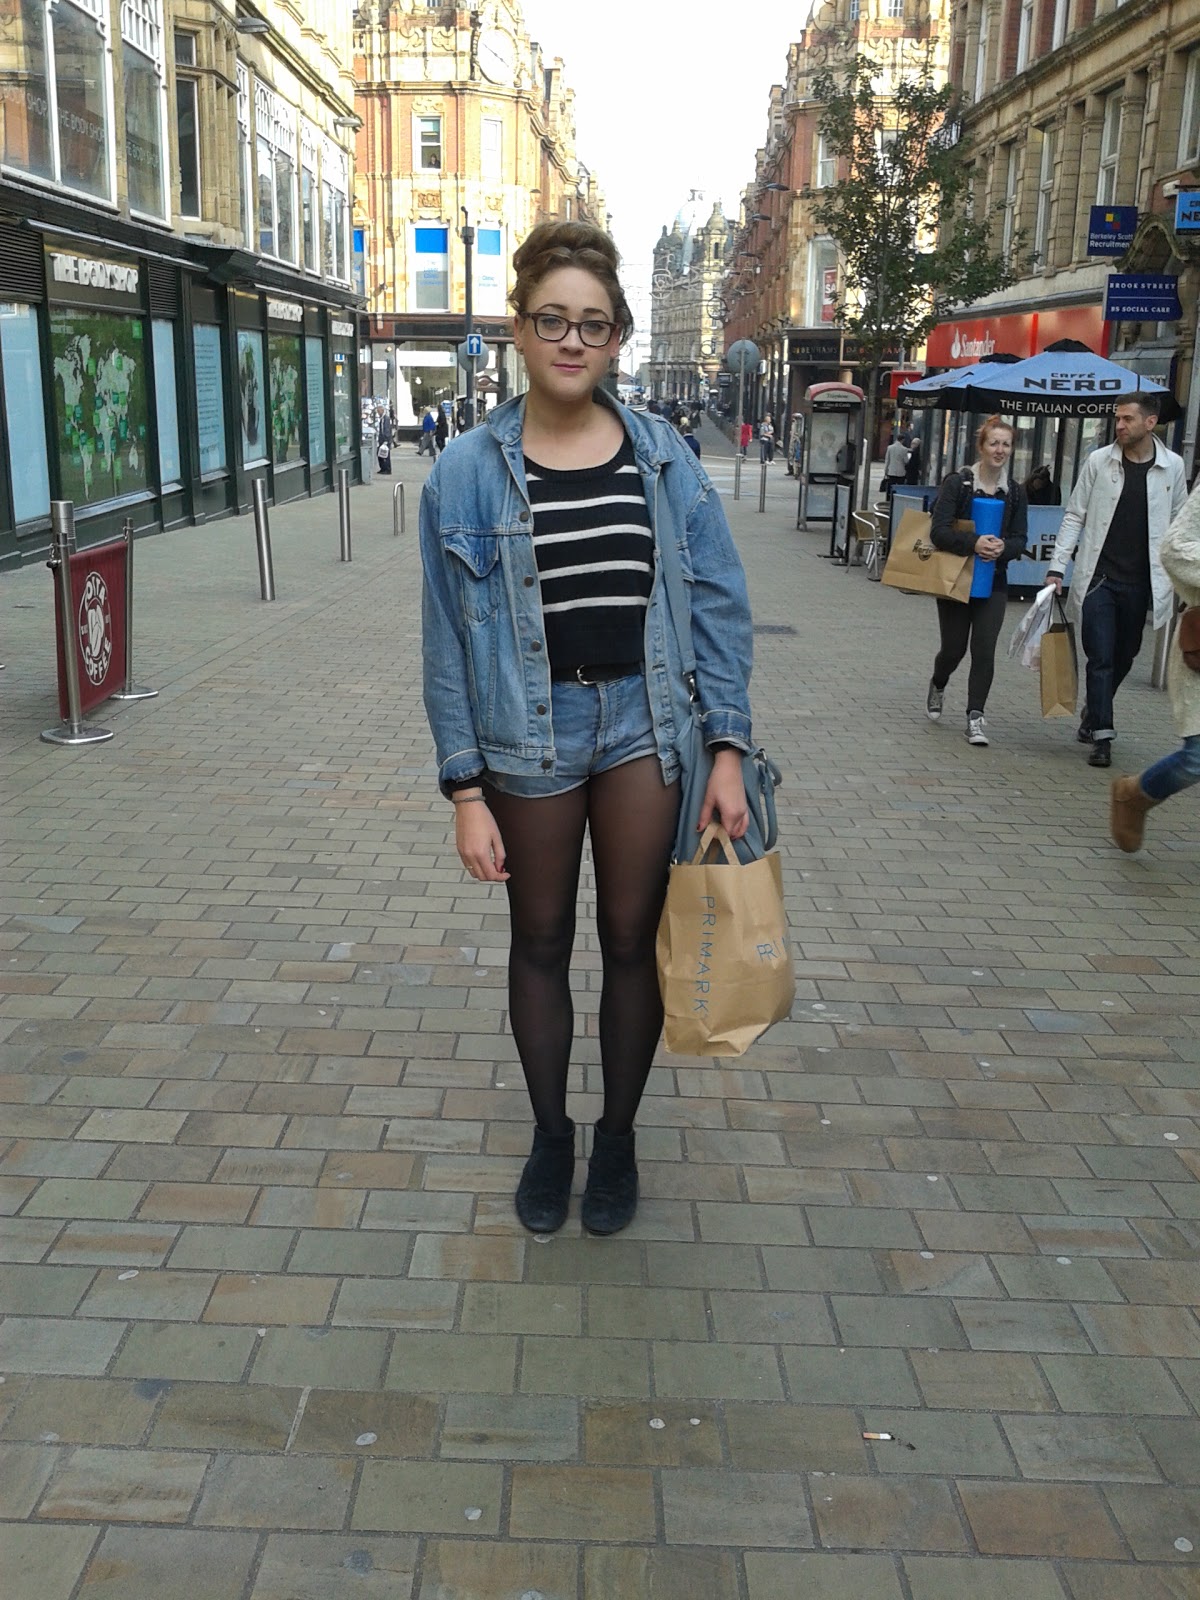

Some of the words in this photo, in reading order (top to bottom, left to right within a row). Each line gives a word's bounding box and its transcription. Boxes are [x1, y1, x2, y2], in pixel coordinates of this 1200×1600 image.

[1089, 240, 1131, 249] Recruitmen
[1090, 233, 1117, 241] Berkeley
[49, 252, 80, 284] THE
[960, 330, 996, 358] Santander
[1023, 377, 1122, 392] NERO
[1000, 399, 1023, 412] THE
[1026, 402, 1073, 415] ITALIAN
[1076, 403, 1118, 415] COFFE
[693, 895, 717, 1014] PRIMARK
